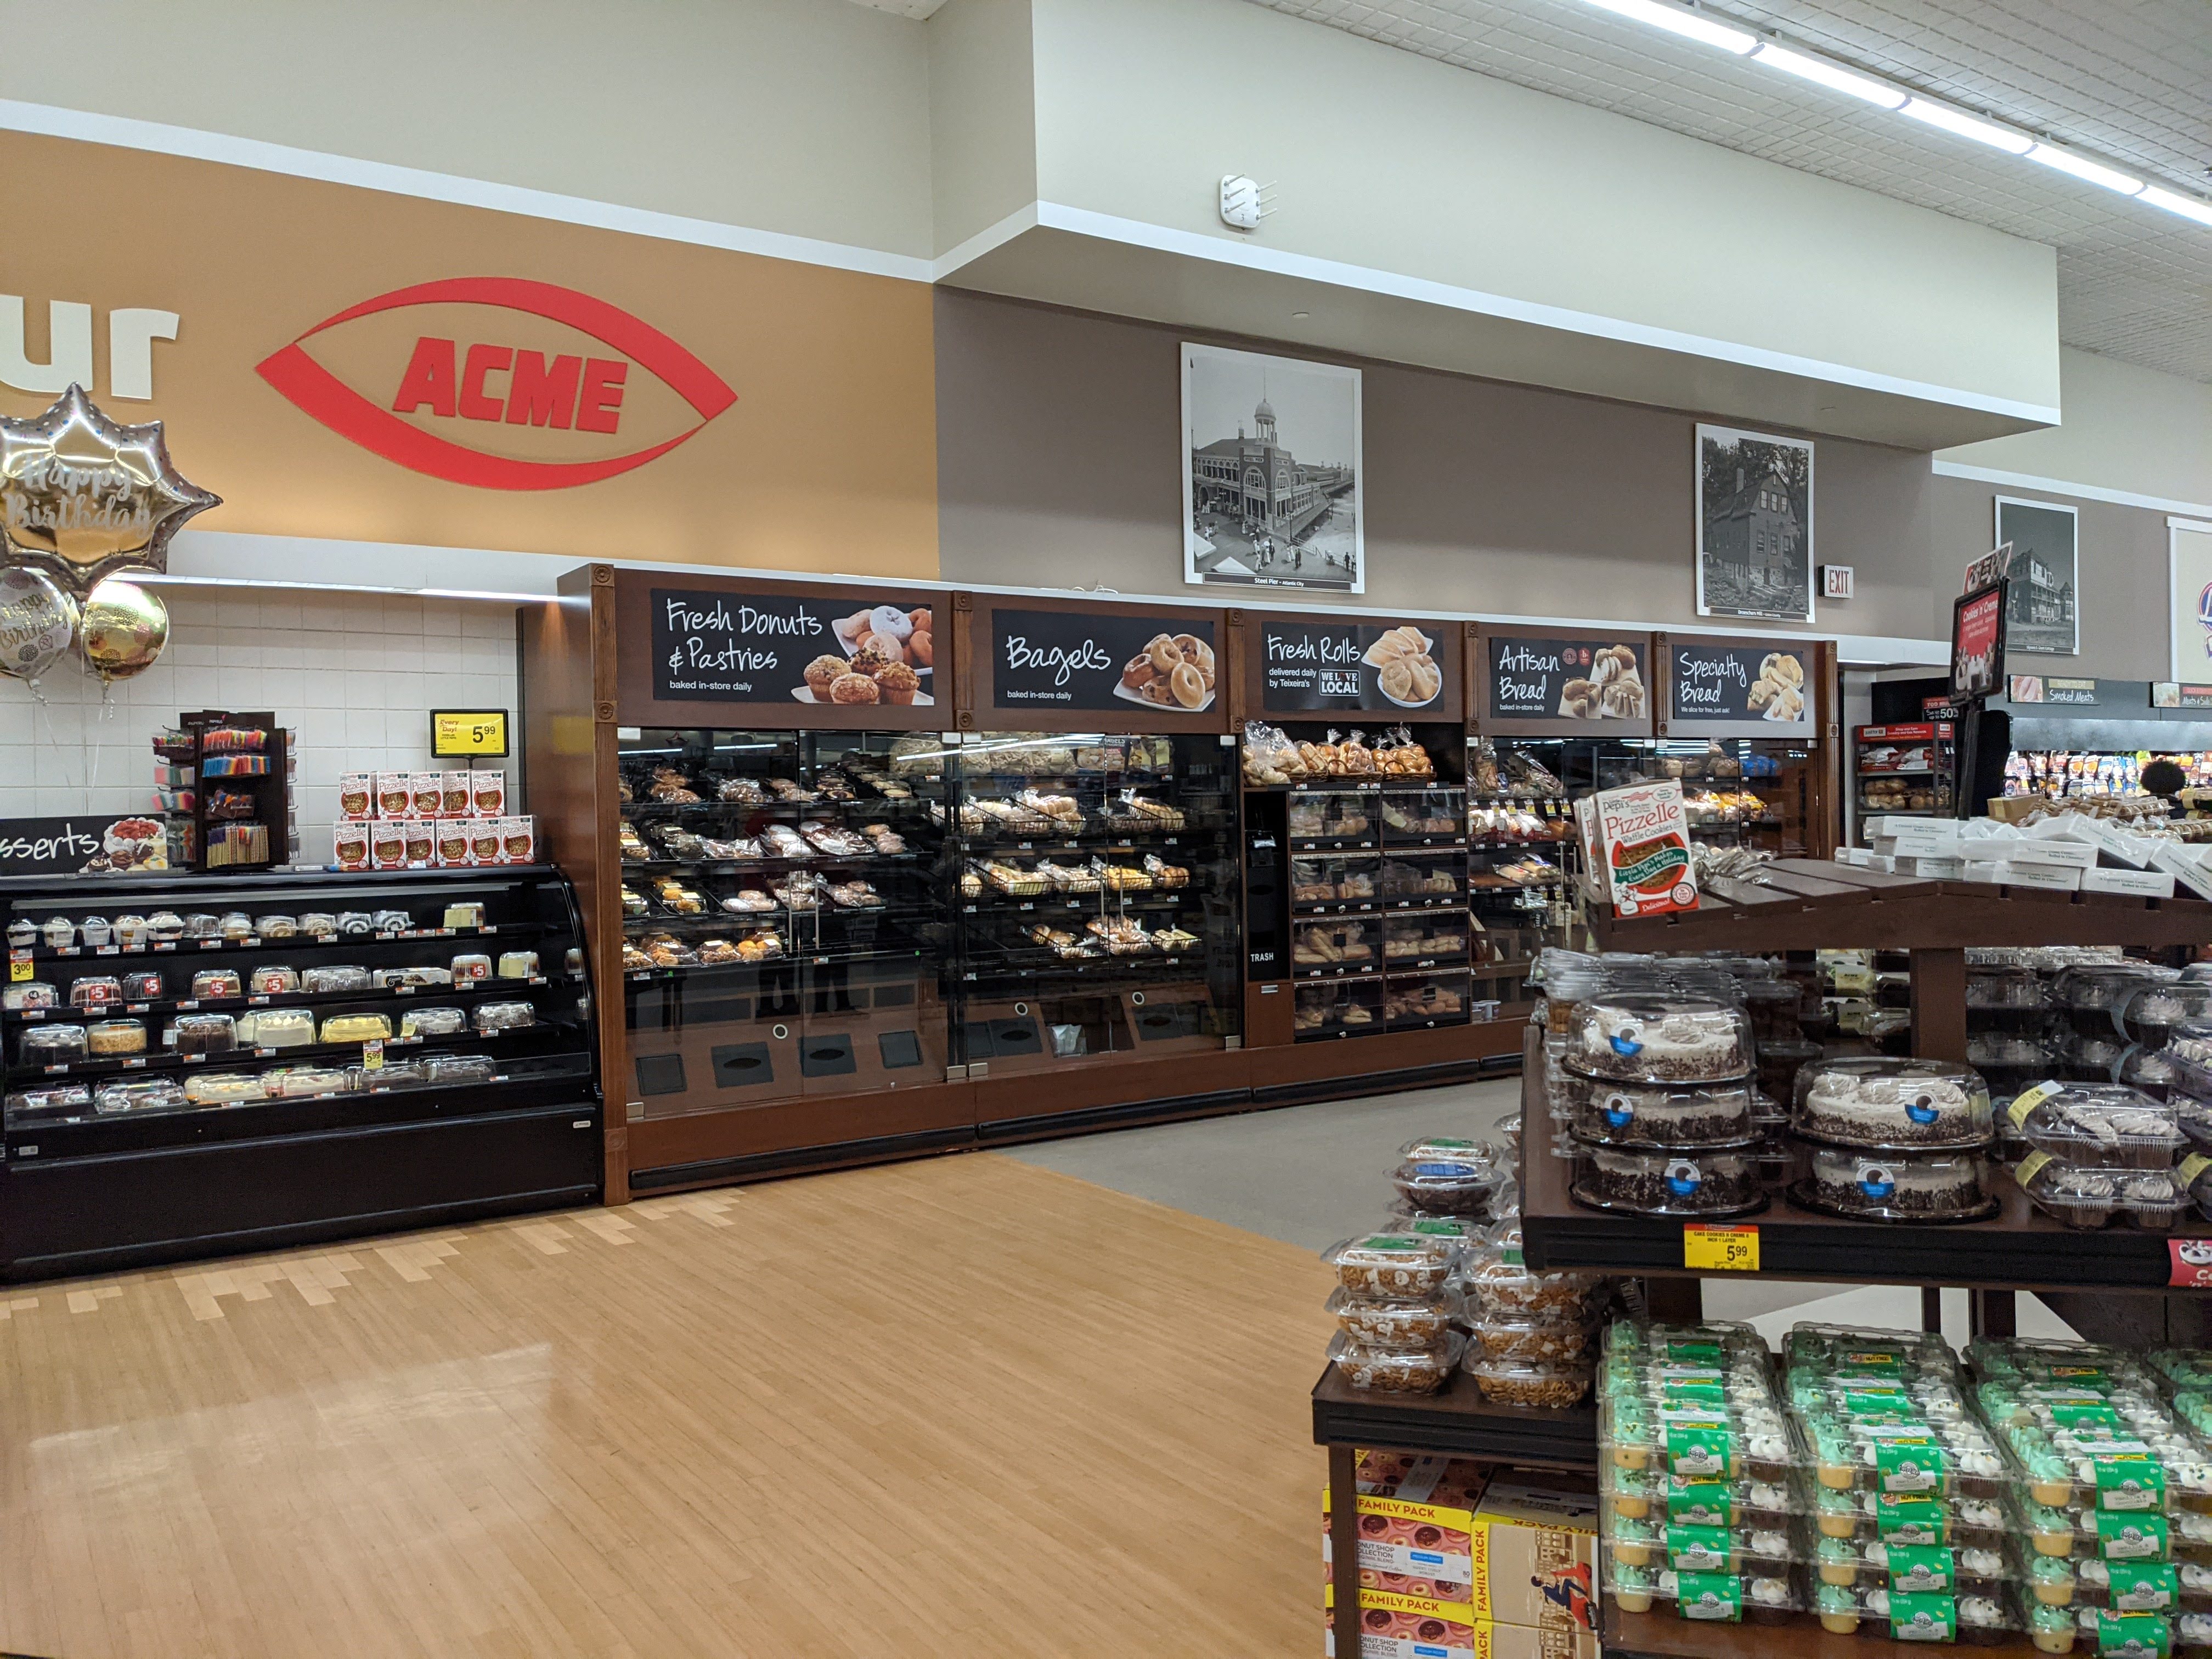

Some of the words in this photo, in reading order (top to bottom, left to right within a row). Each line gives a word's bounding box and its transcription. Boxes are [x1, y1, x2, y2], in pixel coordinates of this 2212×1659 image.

[392, 337, 628, 433] ACME
[22, 452, 132, 501] Happy
[4, 493, 156, 538] Birthday
[1829, 569, 1849, 594] EXIT
[666, 597, 733, 633] Fresh
[738, 605, 822, 636] Donuts
[1267, 633, 1317, 661] Fresh
[1319, 636, 1361, 664] Rolls
[668, 645, 684, 675] &
[687, 636, 777, 672] Pastries
[1005, 635, 1111, 686] Bagels
[1499, 645, 1560, 672] Artisan
[1269, 668, 1300, 676] delivered
[1301, 669, 1317, 679] daily
[1679, 652, 1747, 687] Specialty
[1321, 672, 1333, 681] WE
[669, 680, 696, 690] baked
[698, 681, 731, 691] in-store
[733, 681, 752, 692] daily
[1269, 679, 1278, 689] by
[1279, 679, 1310, 687] Teixeira's
[1321, 681, 1358, 693] LOCAL
[1499, 674, 1547, 701] Bread
[1007, 690, 1029, 699] baked
[1030, 691, 1054, 699] in-store
[1056, 691, 1071, 701] daily
[1680, 679, 1722, 703] Bread
[2049, 689, 2073, 701] Smoked
[2074, 690, 2094, 702] Meats
[340, 780, 368, 792] Pizzelle
[379, 779, 408, 791] Pizzelle
[411, 779, 441, 791] Pizzelle
[473, 778, 501, 789] Pizzelle
[1605, 802, 1680, 840] Pizzelle
[335, 828, 366, 840] Pizzelle
[373, 828, 403, 840] Pizzelle
[438, 826, 466, 838] Pizzelle
[470, 825, 499, 837] Pizzelle
[503, 823, 531, 835] Pizzelle
[1621, 833, 1644, 844] Waffle
[1644, 823, 1673, 837] Cookies
[1642, 899, 1670, 912] Delicious!
[1250, 952, 1274, 962] TRASH
[474, 965, 484, 977] $5
[146, 979, 158, 991] $5
[212, 981, 224, 994] $5
[268, 979, 280, 991] $5
[91, 986, 104, 998] $5
[1358, 1498, 1401, 1513] FAMILY
[1403, 1504, 1436, 1518] PACK
[1357, 1541, 1375, 1549] ONUT
[1475, 1530, 1485, 1564] PACK
[1357, 1548, 1393, 1559] OLLECTION
[1476, 1566, 1487, 1612] FAMILY
[1361, 1593, 1404, 1606] FAMILY
[1407, 1599, 1440, 1612] PACK
[1360, 1635, 1379, 1644] ONUT
[1478, 1630, 1488, 1659] ACK
[1360, 1643, 1397, 1652] OLLECTION
